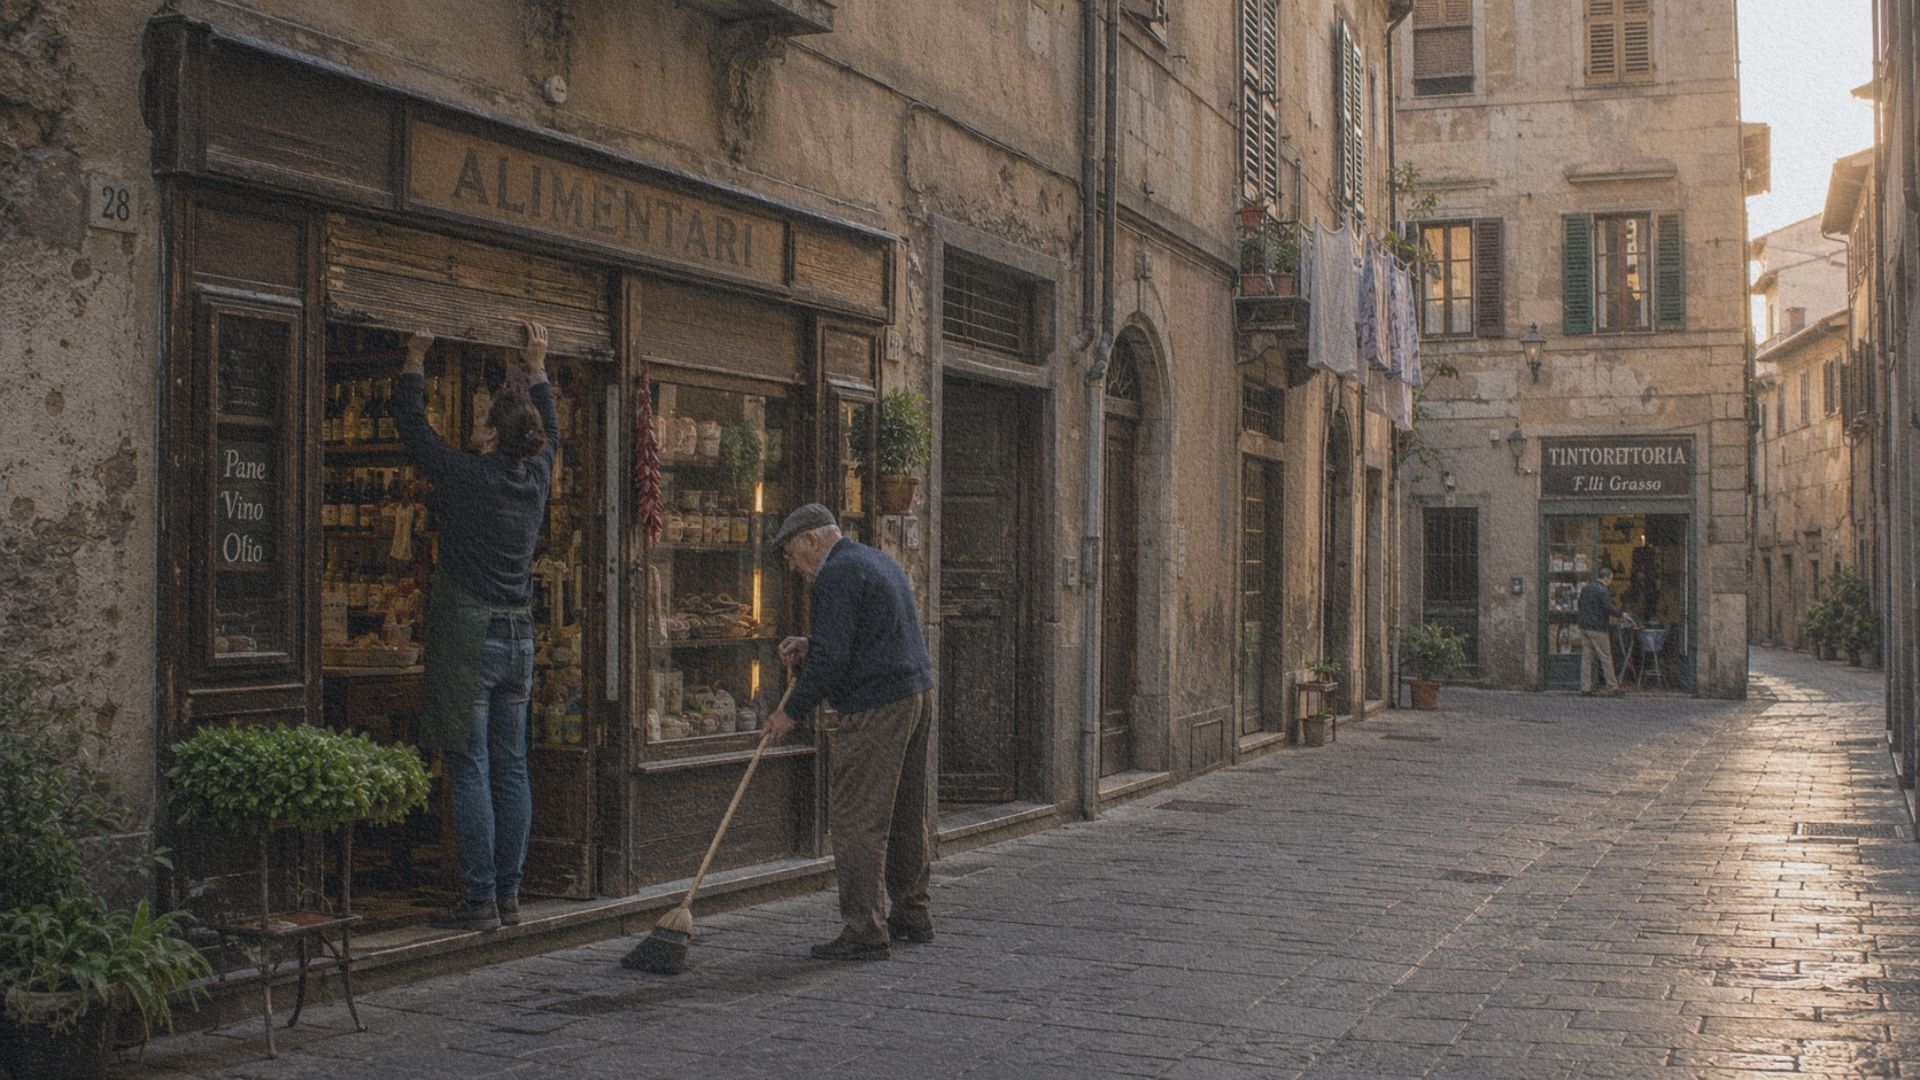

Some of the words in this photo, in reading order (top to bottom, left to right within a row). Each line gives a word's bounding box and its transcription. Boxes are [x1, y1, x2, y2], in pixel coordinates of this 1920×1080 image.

[102, 186, 130, 221] 28
[452, 147, 751, 268] ALIMENTARI
[223, 449, 266, 480] Pane
[1609, 475, 1662, 491] Grasso
[221, 491, 264, 521] Vino
[223, 532, 263, 563] Olio
